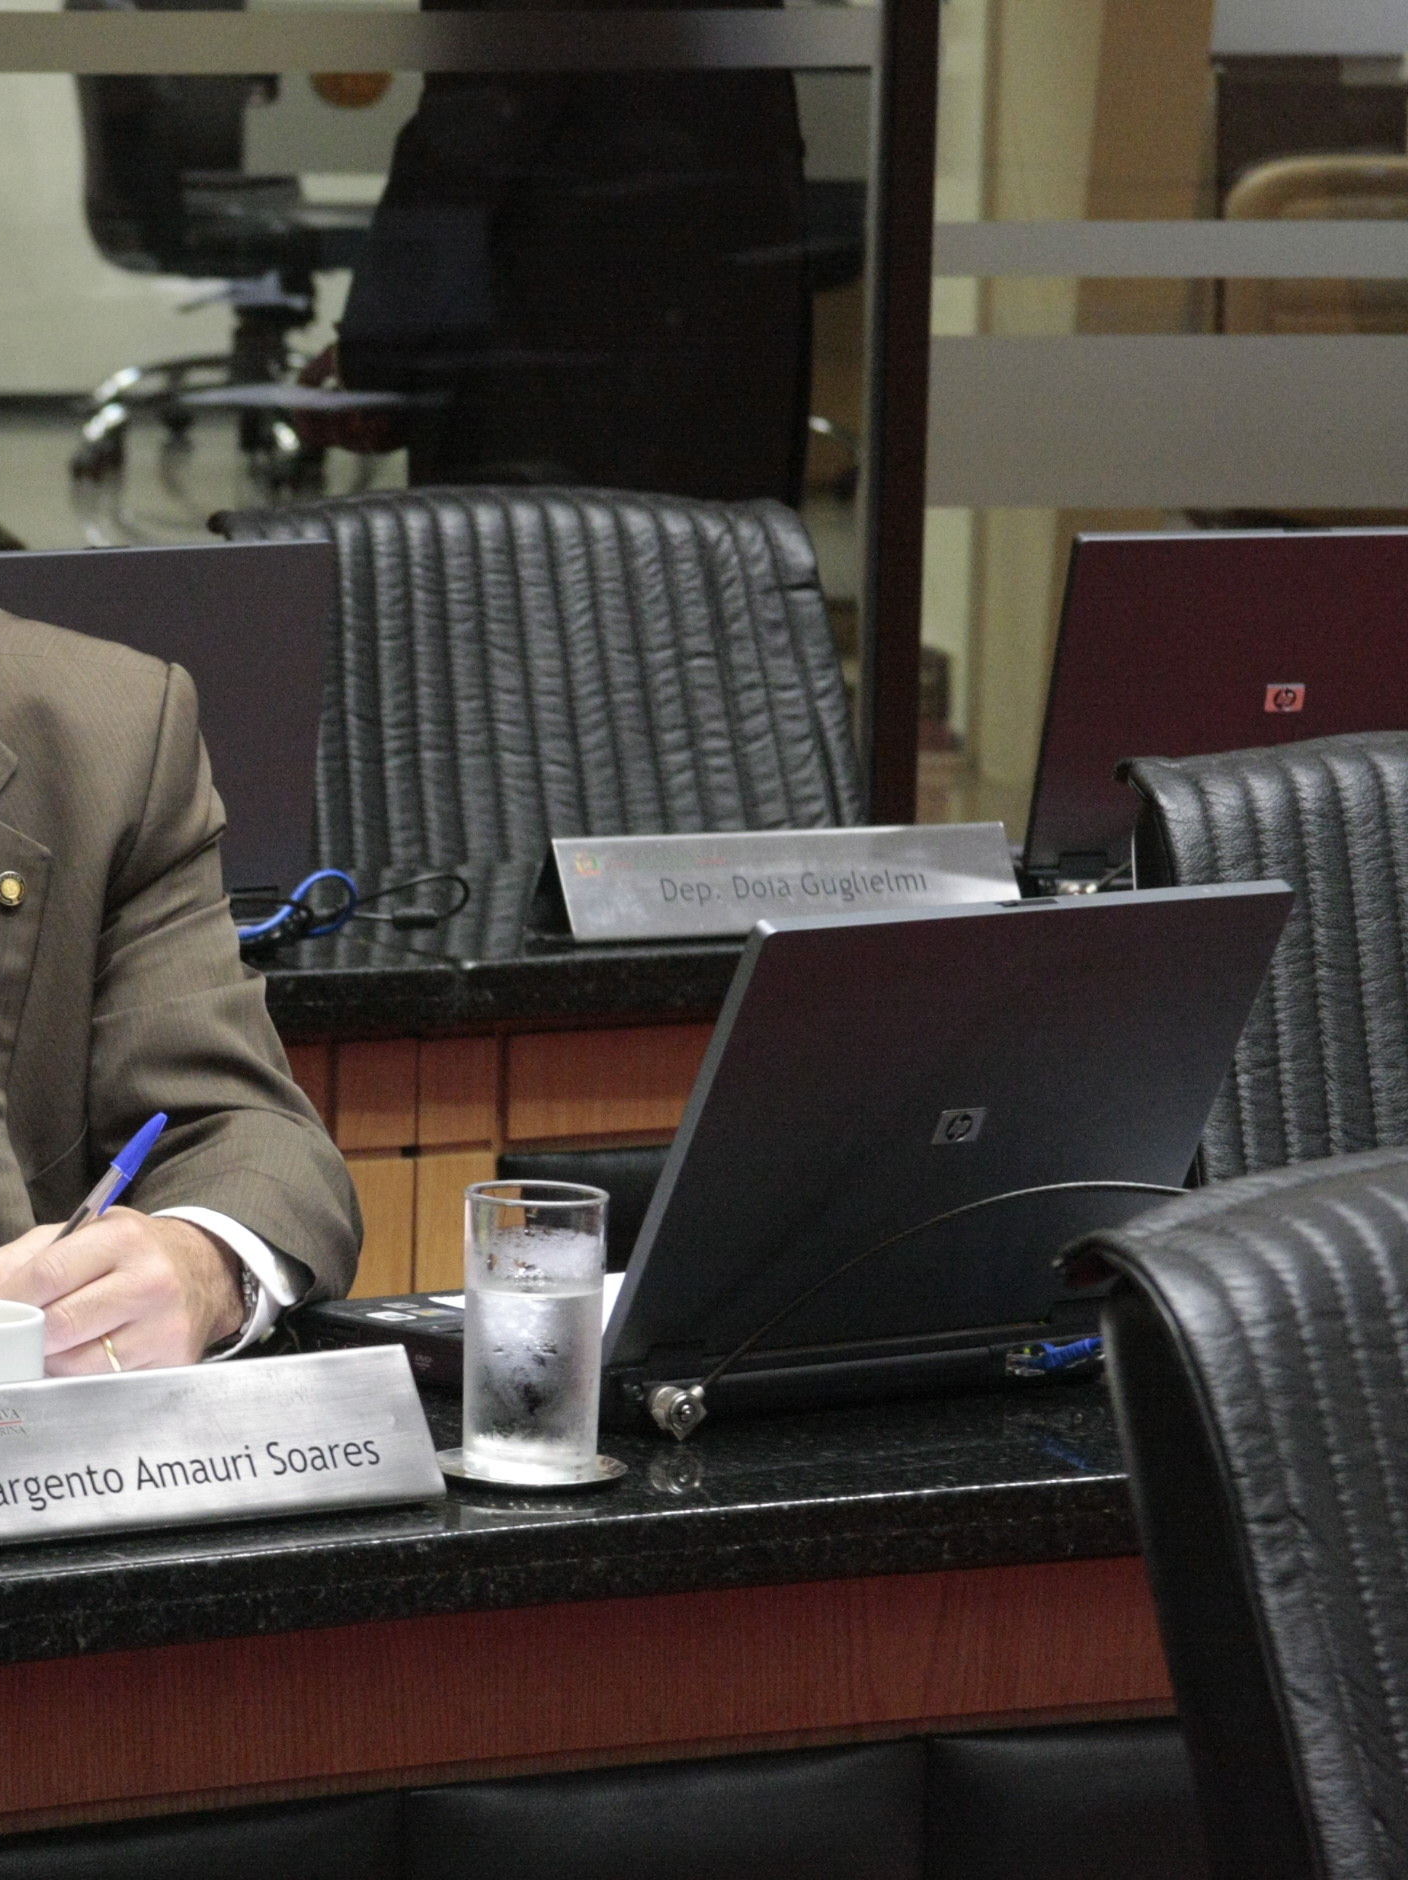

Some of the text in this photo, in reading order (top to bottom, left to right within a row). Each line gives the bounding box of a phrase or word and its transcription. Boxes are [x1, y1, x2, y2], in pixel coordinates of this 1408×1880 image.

[659, 876, 722, 906] Dep.
[799, 868, 928, 902] Guglielmi
[136, 1445, 258, 1491] Amauri
[265, 1440, 381, 1476] Soares
